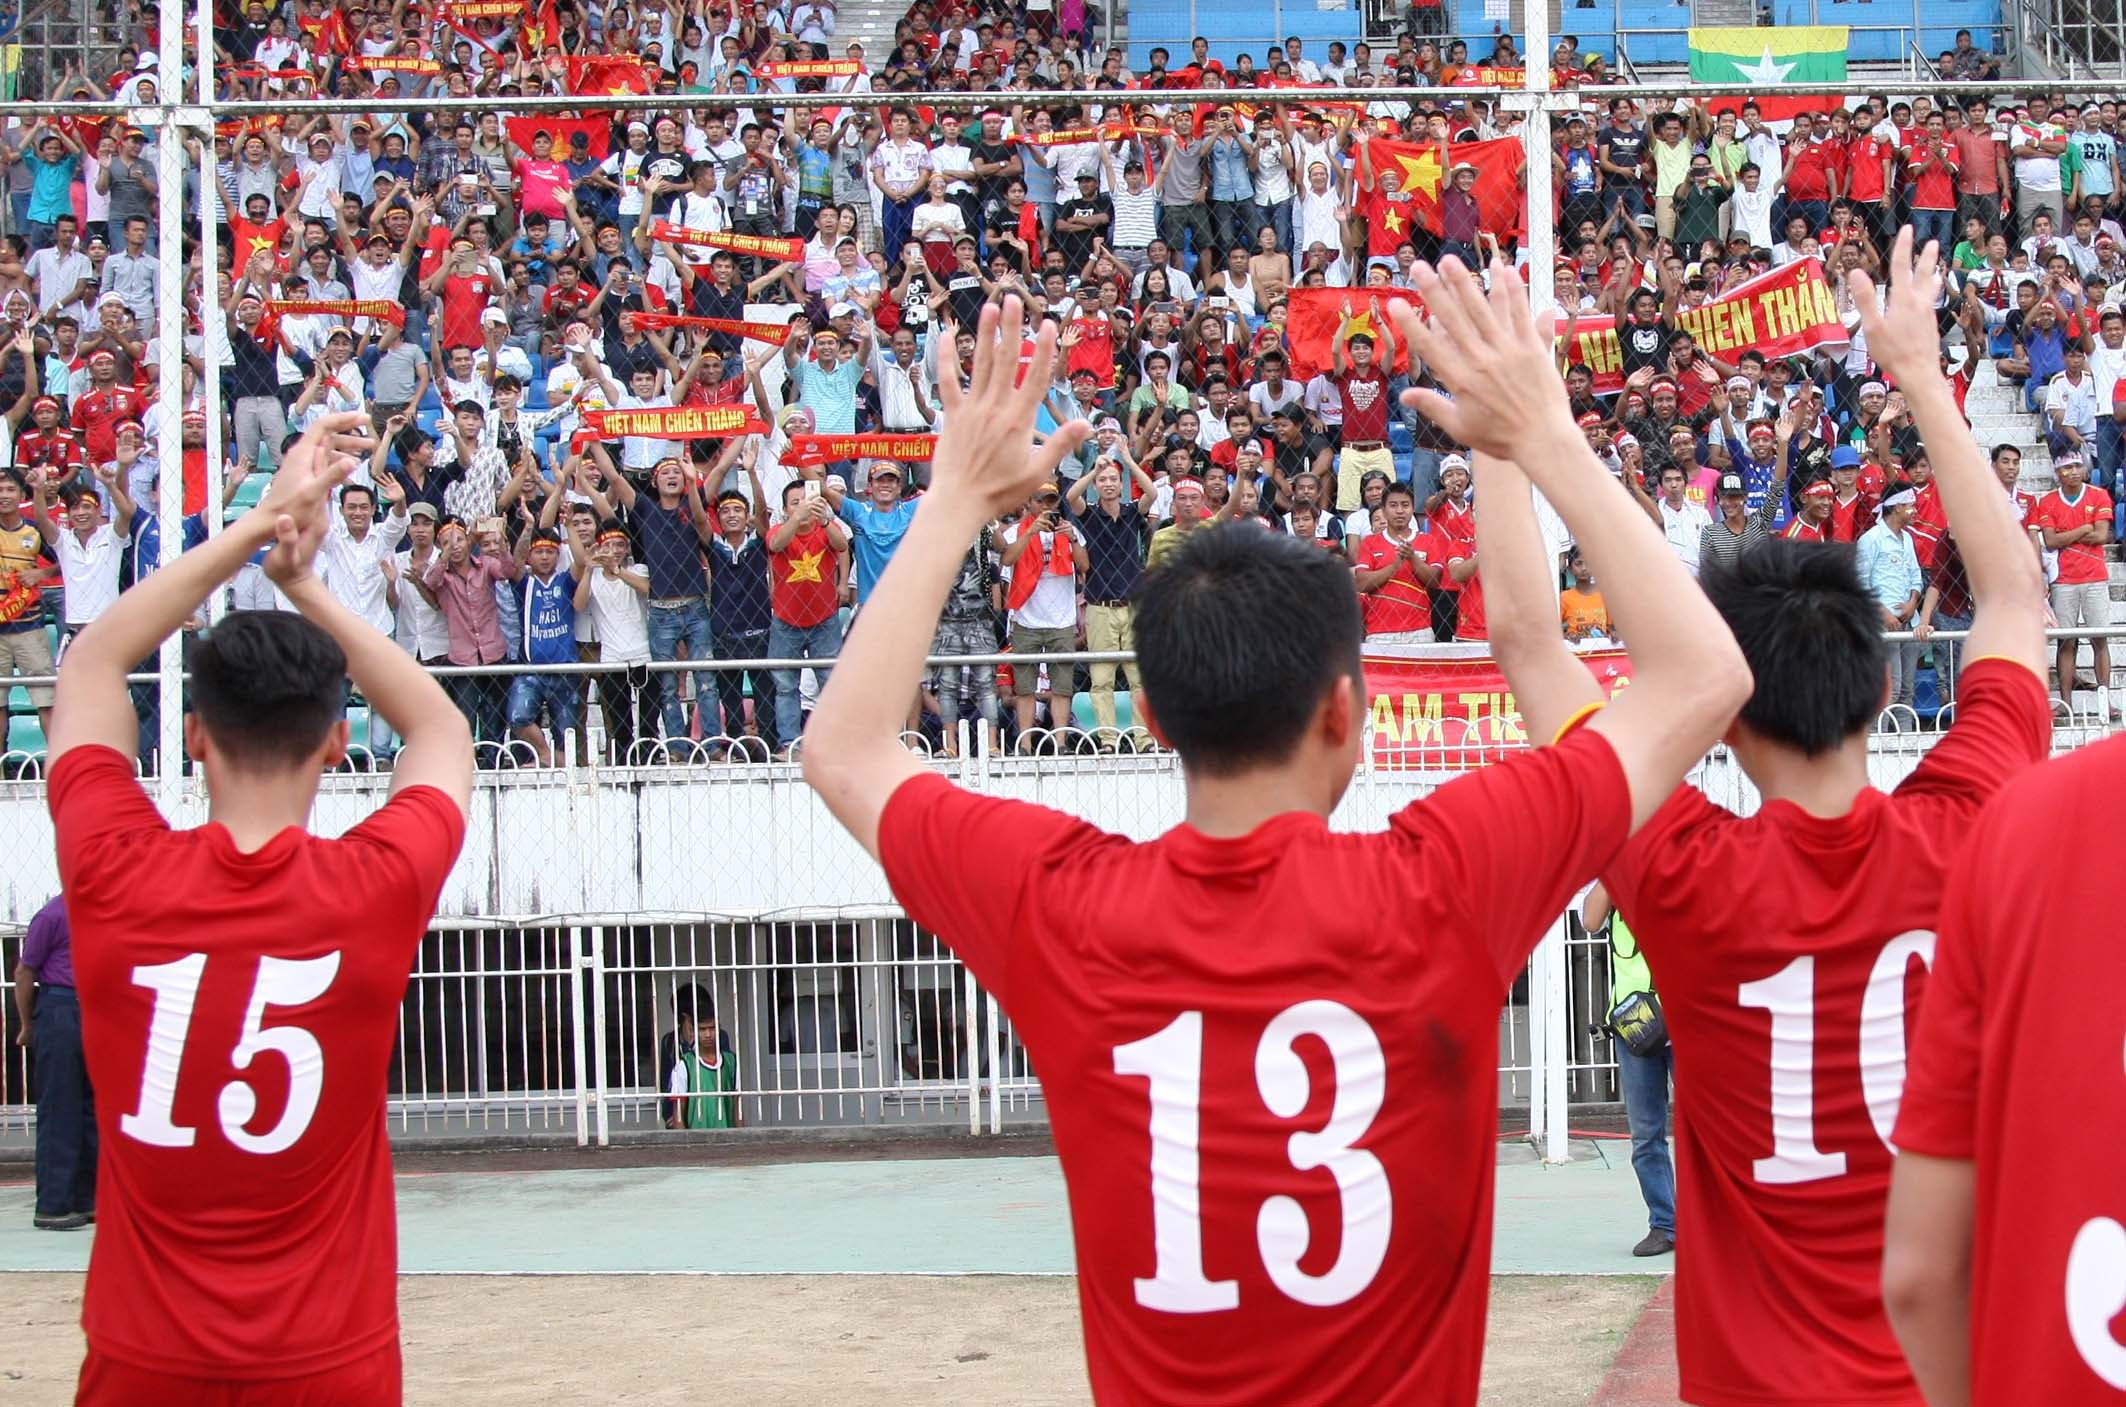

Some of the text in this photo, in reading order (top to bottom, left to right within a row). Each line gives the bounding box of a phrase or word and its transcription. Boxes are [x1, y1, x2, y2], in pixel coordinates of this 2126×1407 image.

[1578, 328, 1624, 374] NA
[1759, 266, 1841, 339] THẮN
[632, 413, 661, 433] NAM
[860, 442, 889, 457] NAM
[1371, 693, 1442, 742] AM
[121, 951, 341, 1154] 15
[1113, 1000, 1392, 1313] 13
